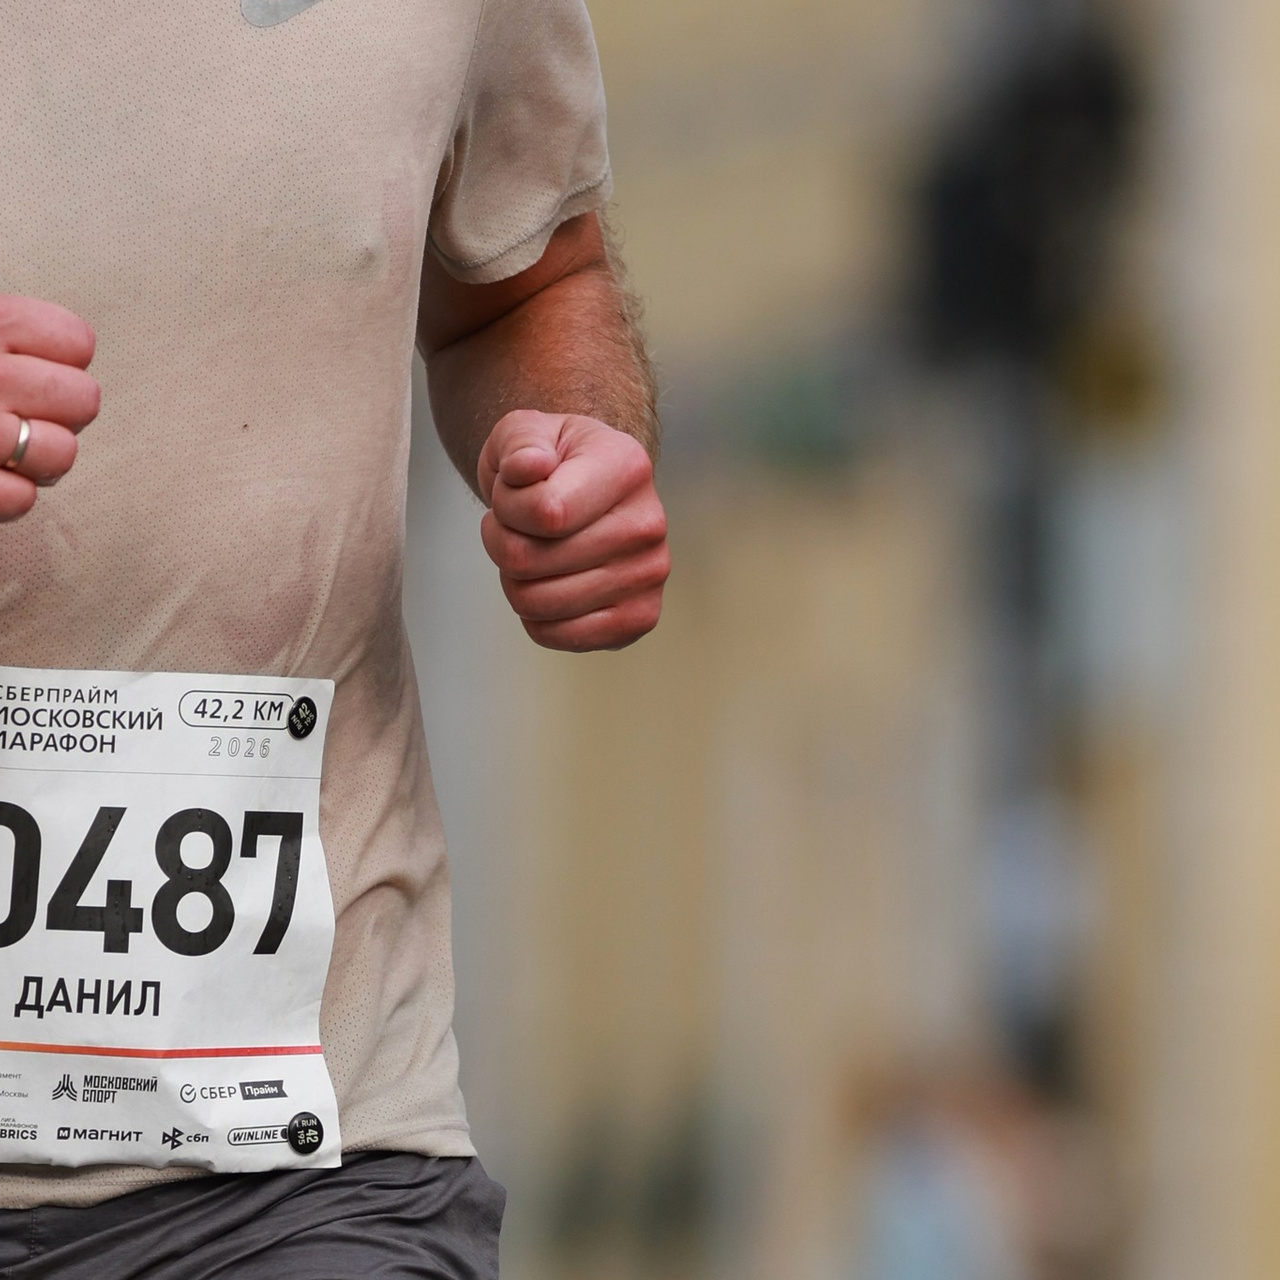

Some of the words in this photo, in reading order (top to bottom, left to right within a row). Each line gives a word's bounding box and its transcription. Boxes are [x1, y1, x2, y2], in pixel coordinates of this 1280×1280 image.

[193, 698, 245, 723] 42,2
[253, 700, 284, 721] КМ
[298, 702, 311, 718] 42
[290, 715, 303, 731] RUN
[303, 712, 315, 727] 195
[208, 736, 271, 758] 2026
[13, 975, 161, 1020] ДАНИЛ
[83, 1075, 158, 1093] МОСКОВСКИЙ
[200, 1086, 237, 1100] СБЕР
[244, 1084, 279, 1097] Прайм
[82, 1089, 118, 1104] СПОРТ
[301, 1118, 318, 1127] RUN
[0, 1129, 38, 1141] BRICS
[186, 1133, 210, 1143] сбп
[233, 1129, 279, 1142] WINLINE
[297, 1129, 306, 1146] 195
[306, 1128, 319, 1144] 42
